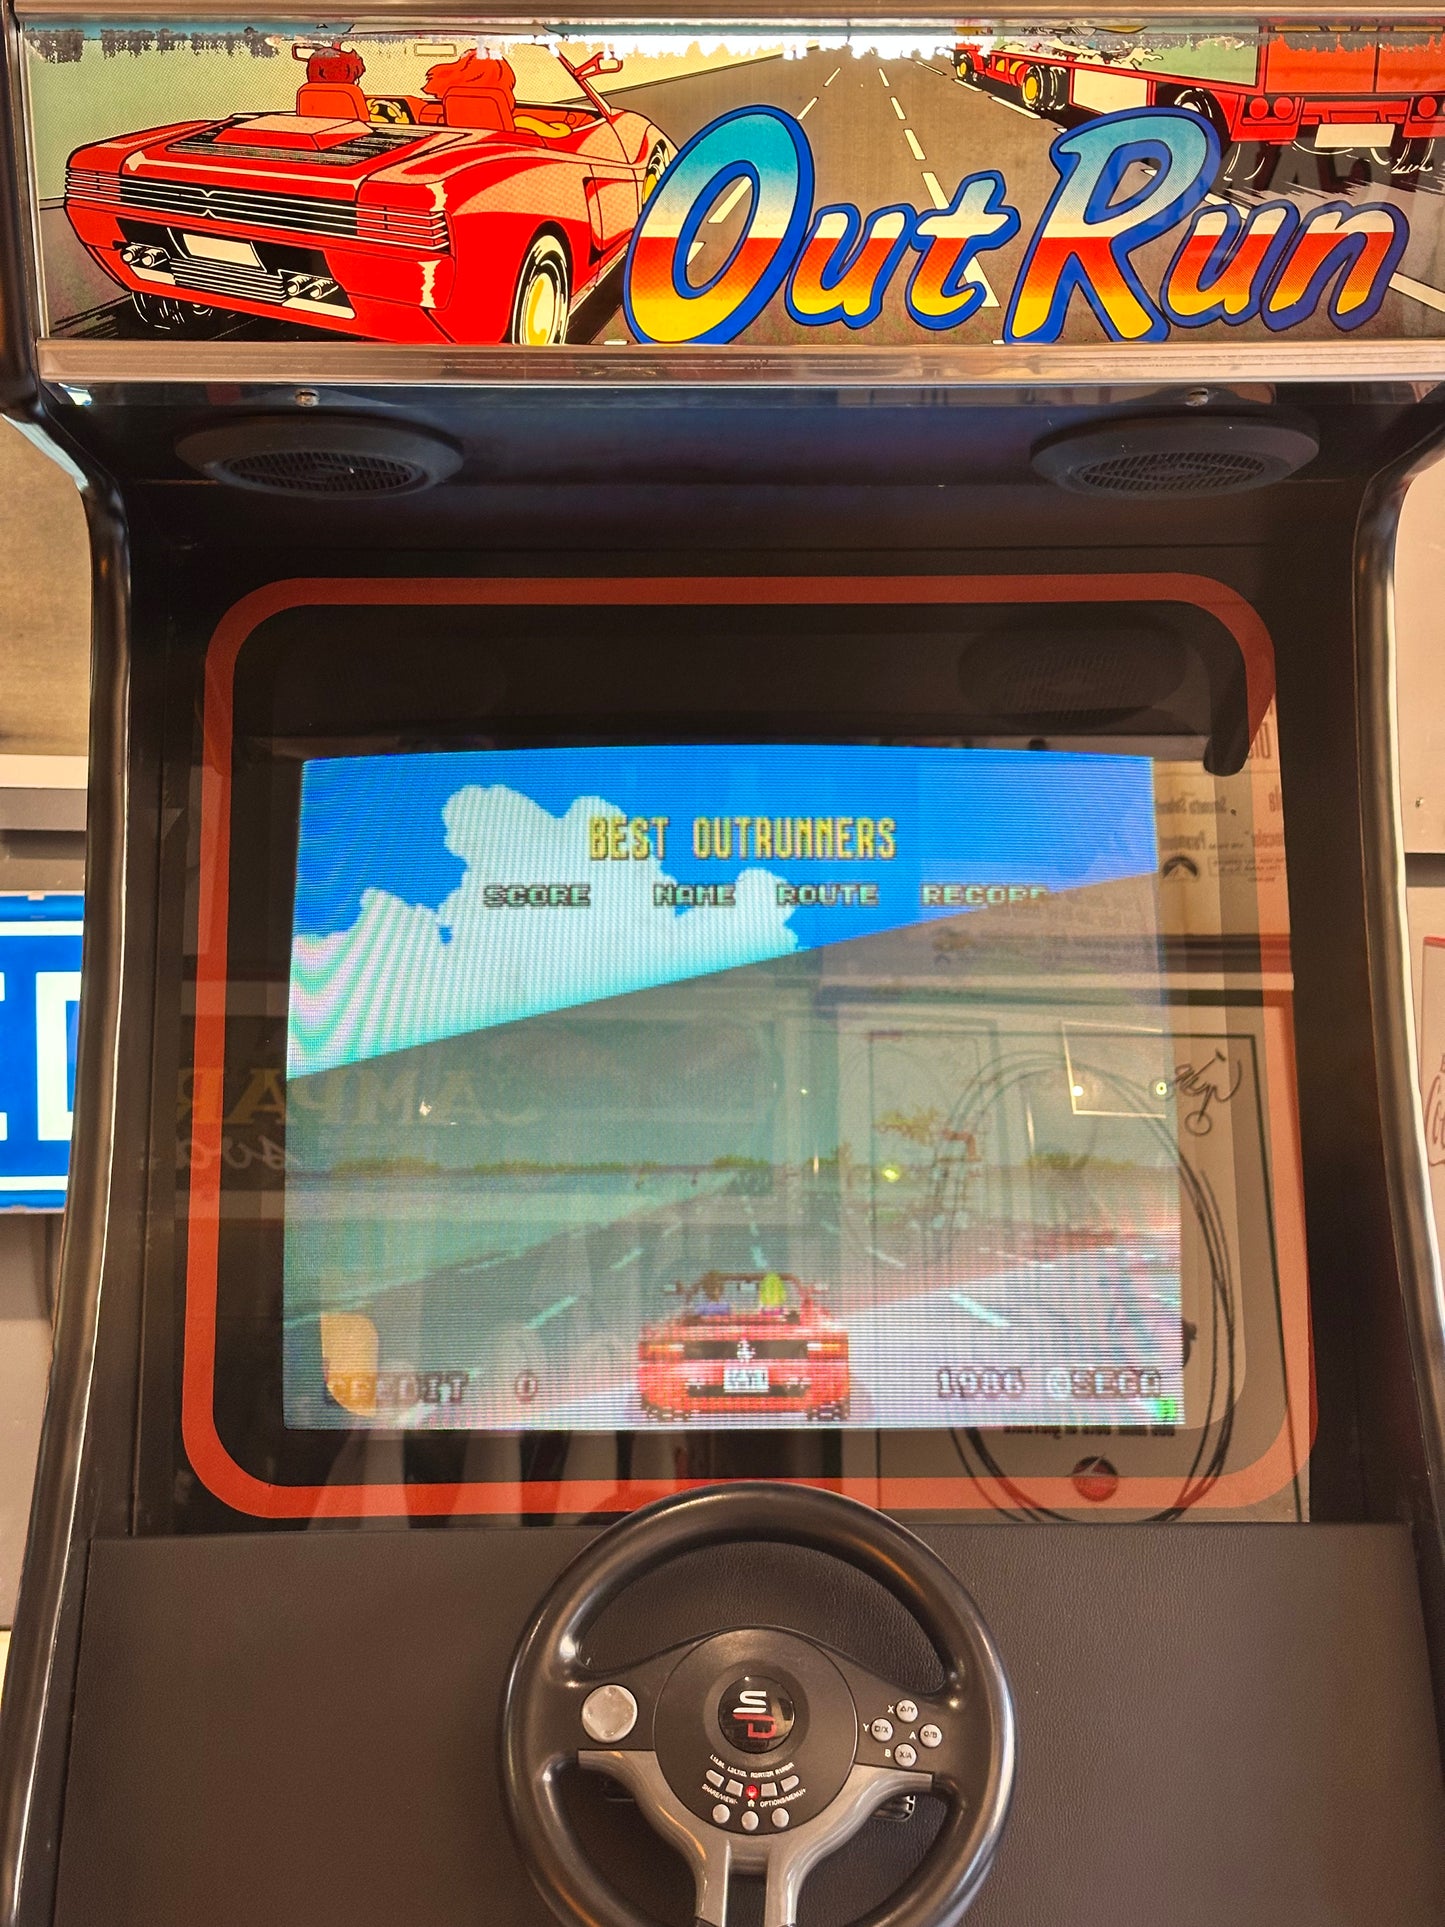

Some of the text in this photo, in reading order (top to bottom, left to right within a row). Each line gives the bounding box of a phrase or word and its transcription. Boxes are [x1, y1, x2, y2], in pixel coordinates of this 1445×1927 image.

[624, 104, 1410, 343] Out Run
[588, 816, 898, 861] BEST OUTRUNNERS
[483, 883, 592, 907] SCORE
[654, 883, 736, 907] NAME
[776, 883, 879, 907] ROUTE
